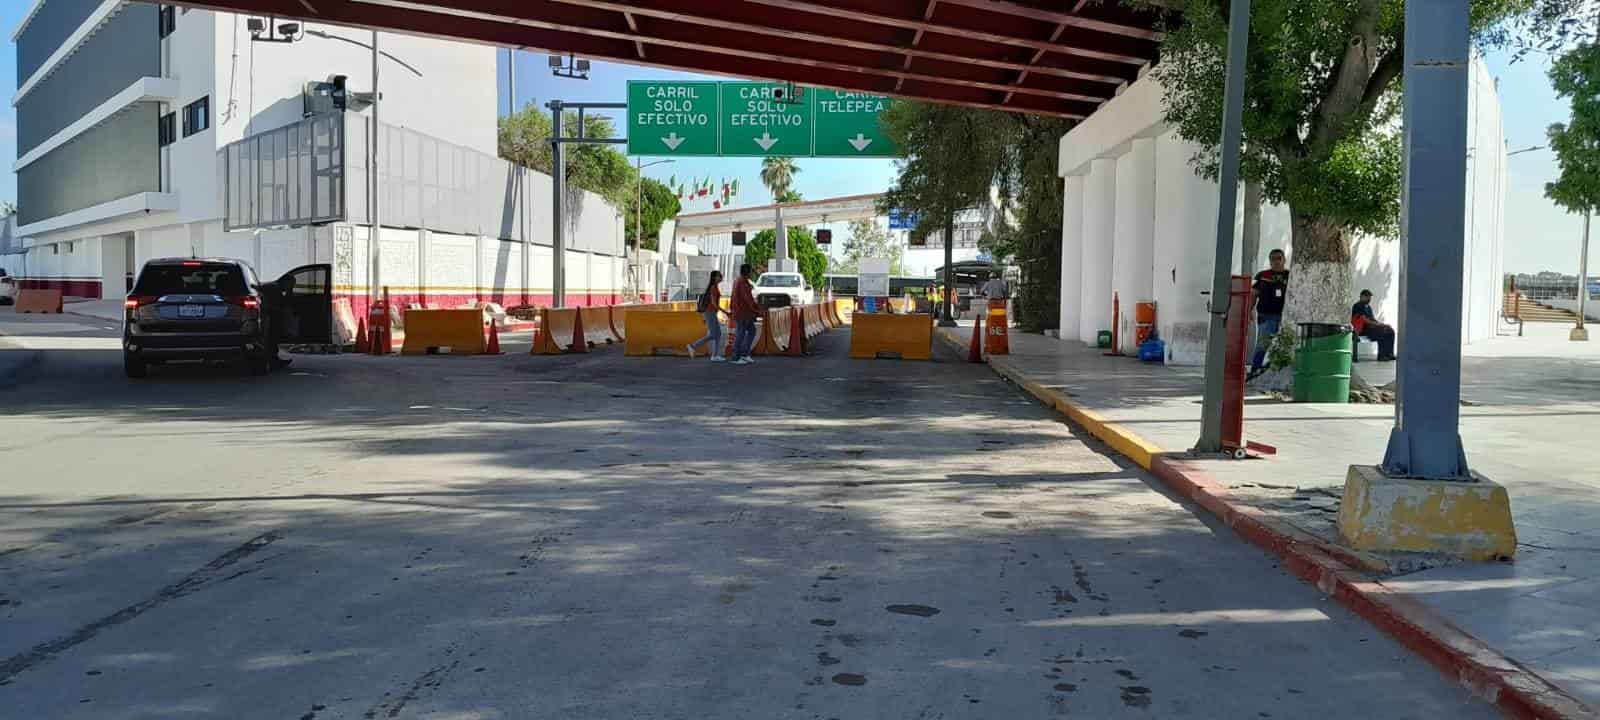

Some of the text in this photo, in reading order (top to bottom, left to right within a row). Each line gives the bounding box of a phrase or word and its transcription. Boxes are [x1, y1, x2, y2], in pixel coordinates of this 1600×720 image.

[647, 86, 700, 99] CARRIL
[654, 99, 693, 112] SOLO
[747, 100, 787, 112] SOLO
[637, 112, 708, 125] EFECTIVO
[731, 113, 802, 126] EFECTIVO
